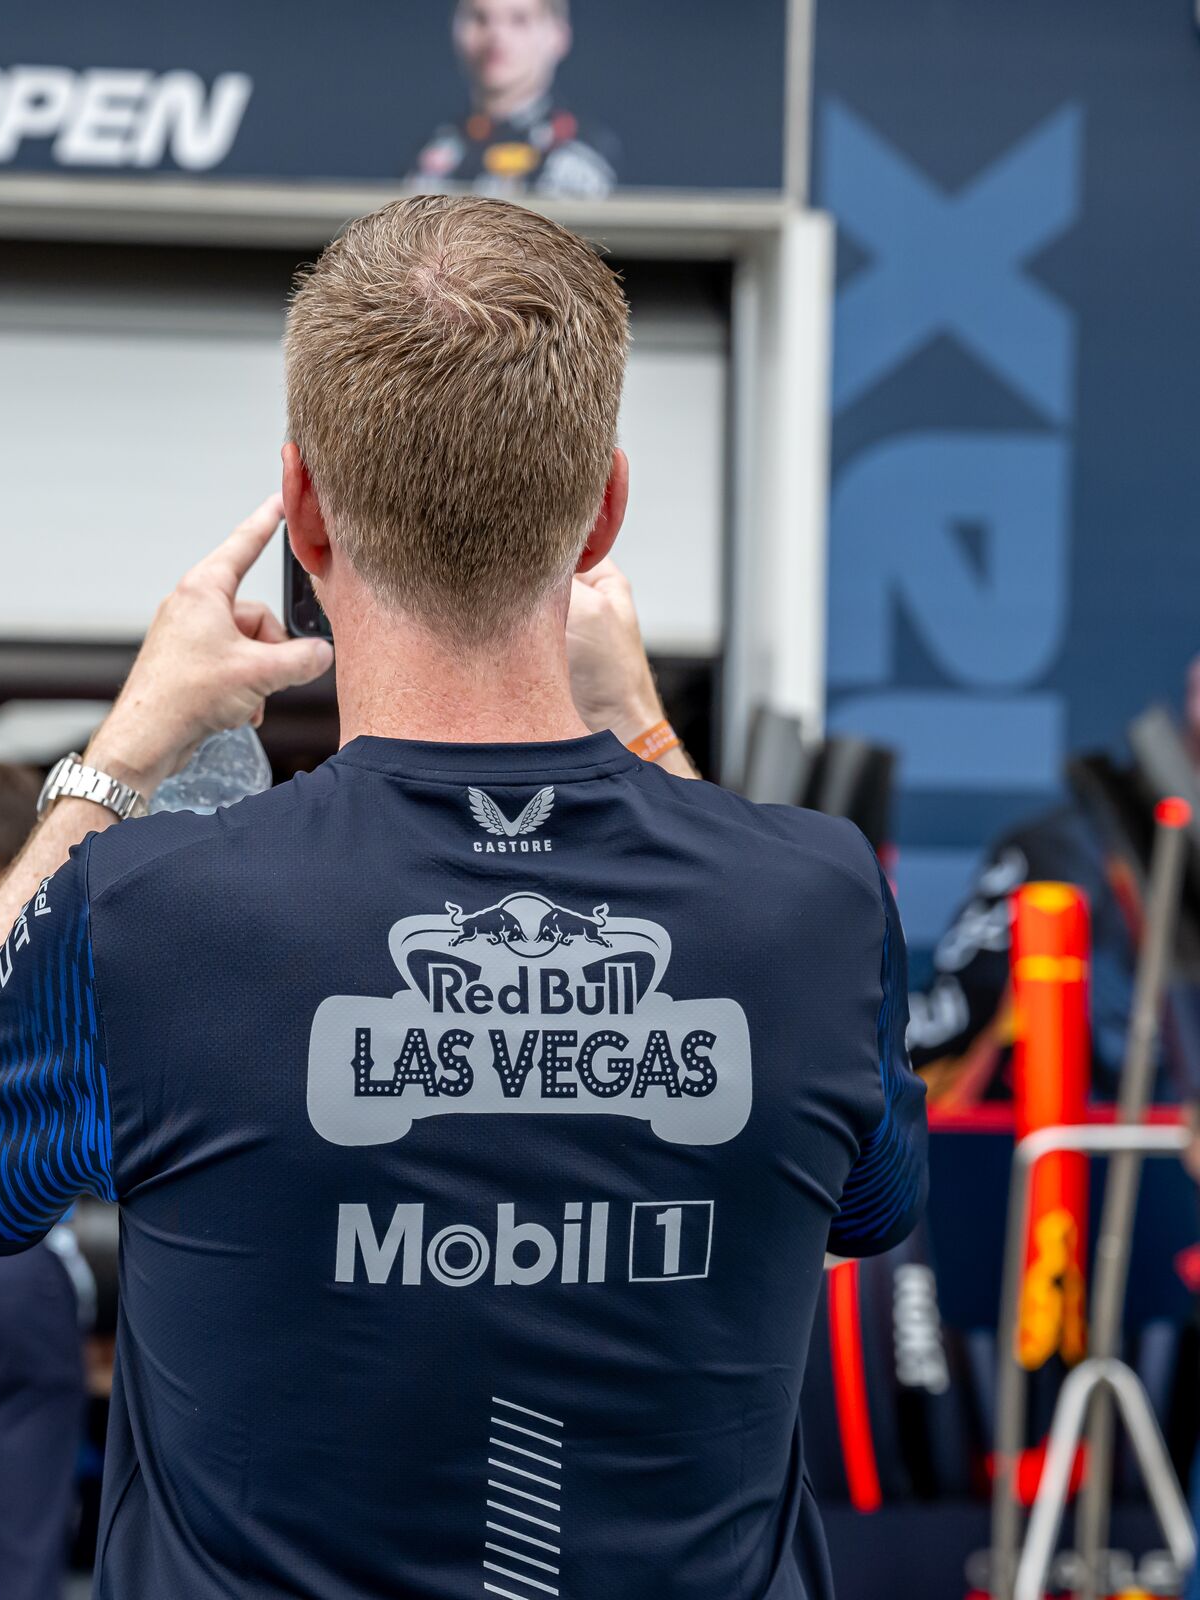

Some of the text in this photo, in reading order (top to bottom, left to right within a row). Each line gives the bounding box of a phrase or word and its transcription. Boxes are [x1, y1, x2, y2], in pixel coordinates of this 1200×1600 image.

[472, 838, 553, 854] CASTORE
[432, 964, 636, 1015] Red Bull
[350, 1027, 718, 1099] LAS VEGAS
[334, 1200, 683, 1288] Mobil 1
